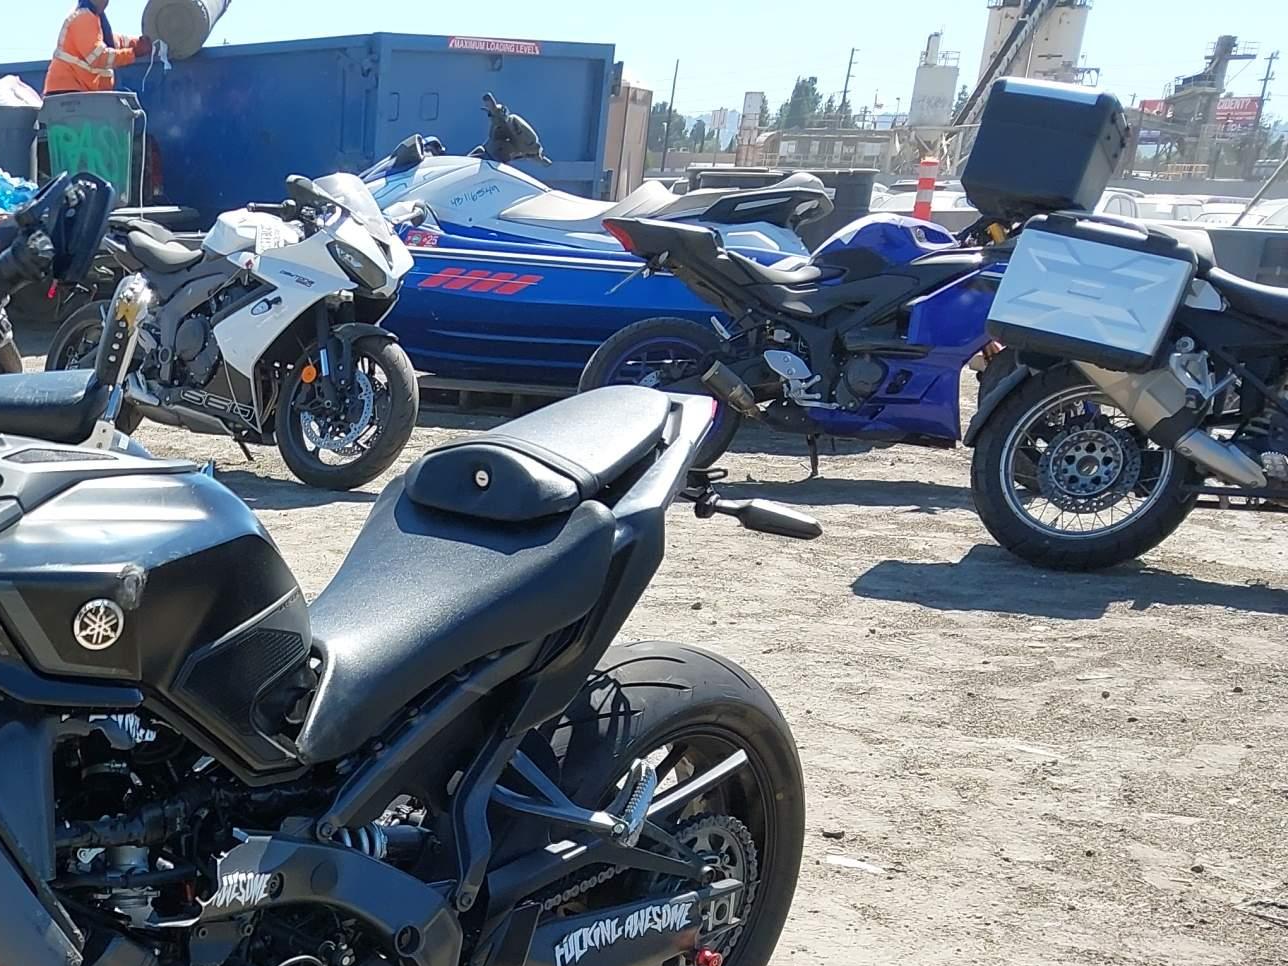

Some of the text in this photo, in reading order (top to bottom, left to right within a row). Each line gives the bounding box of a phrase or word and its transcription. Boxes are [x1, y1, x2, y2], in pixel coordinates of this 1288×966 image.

[454, 39, 536, 55] MAXIMUM LOADING LEVEL
[1216, 98, 1250, 110] CIDENT?
[624, 902, 693, 940] AWESOME
